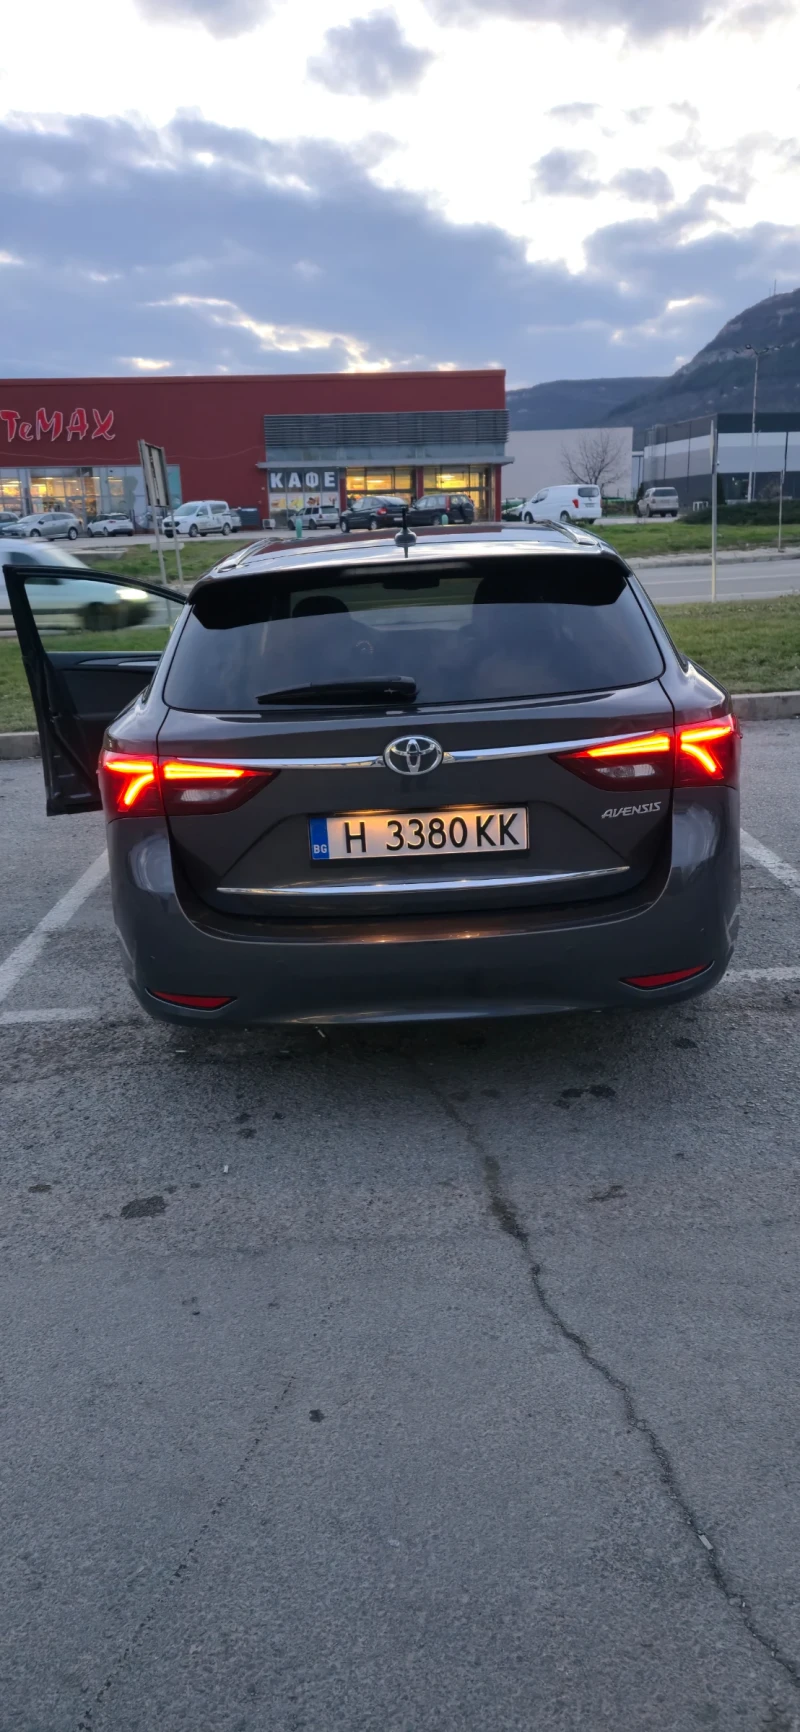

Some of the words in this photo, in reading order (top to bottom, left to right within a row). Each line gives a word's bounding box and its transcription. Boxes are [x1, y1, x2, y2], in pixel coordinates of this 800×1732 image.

[270, 471, 336, 489] КАФЕ
[601, 801, 662, 819] AVENSIS
[344, 821, 367, 854] H
[386, 816, 469, 852] 3380
[475, 812, 521, 848] KK
[313, 843, 328, 855] BG
